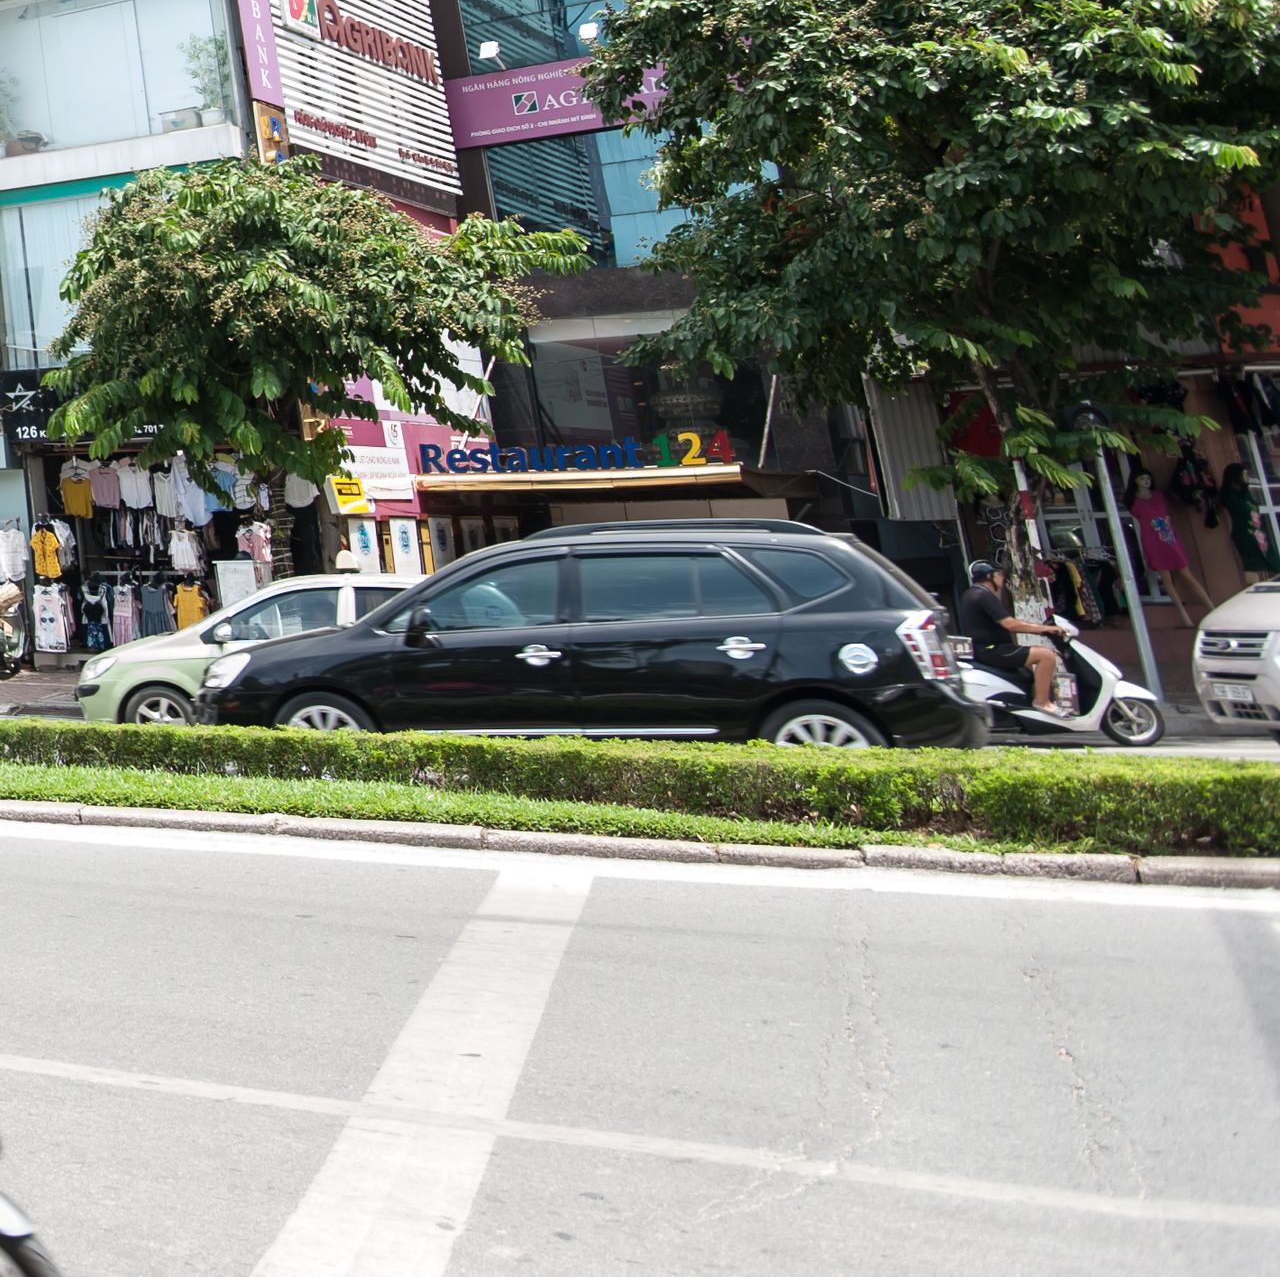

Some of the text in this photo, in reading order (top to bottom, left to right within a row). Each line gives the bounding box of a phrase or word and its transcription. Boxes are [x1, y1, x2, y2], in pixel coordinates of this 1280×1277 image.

[487, 78, 510, 89] HÀNG
[512, 74, 536, 85] NÔNG
[538, 69, 569, 82] NGHIỆ
[16, 426, 37, 438] 126
[419, 430, 734, 474] Restaurant 124
